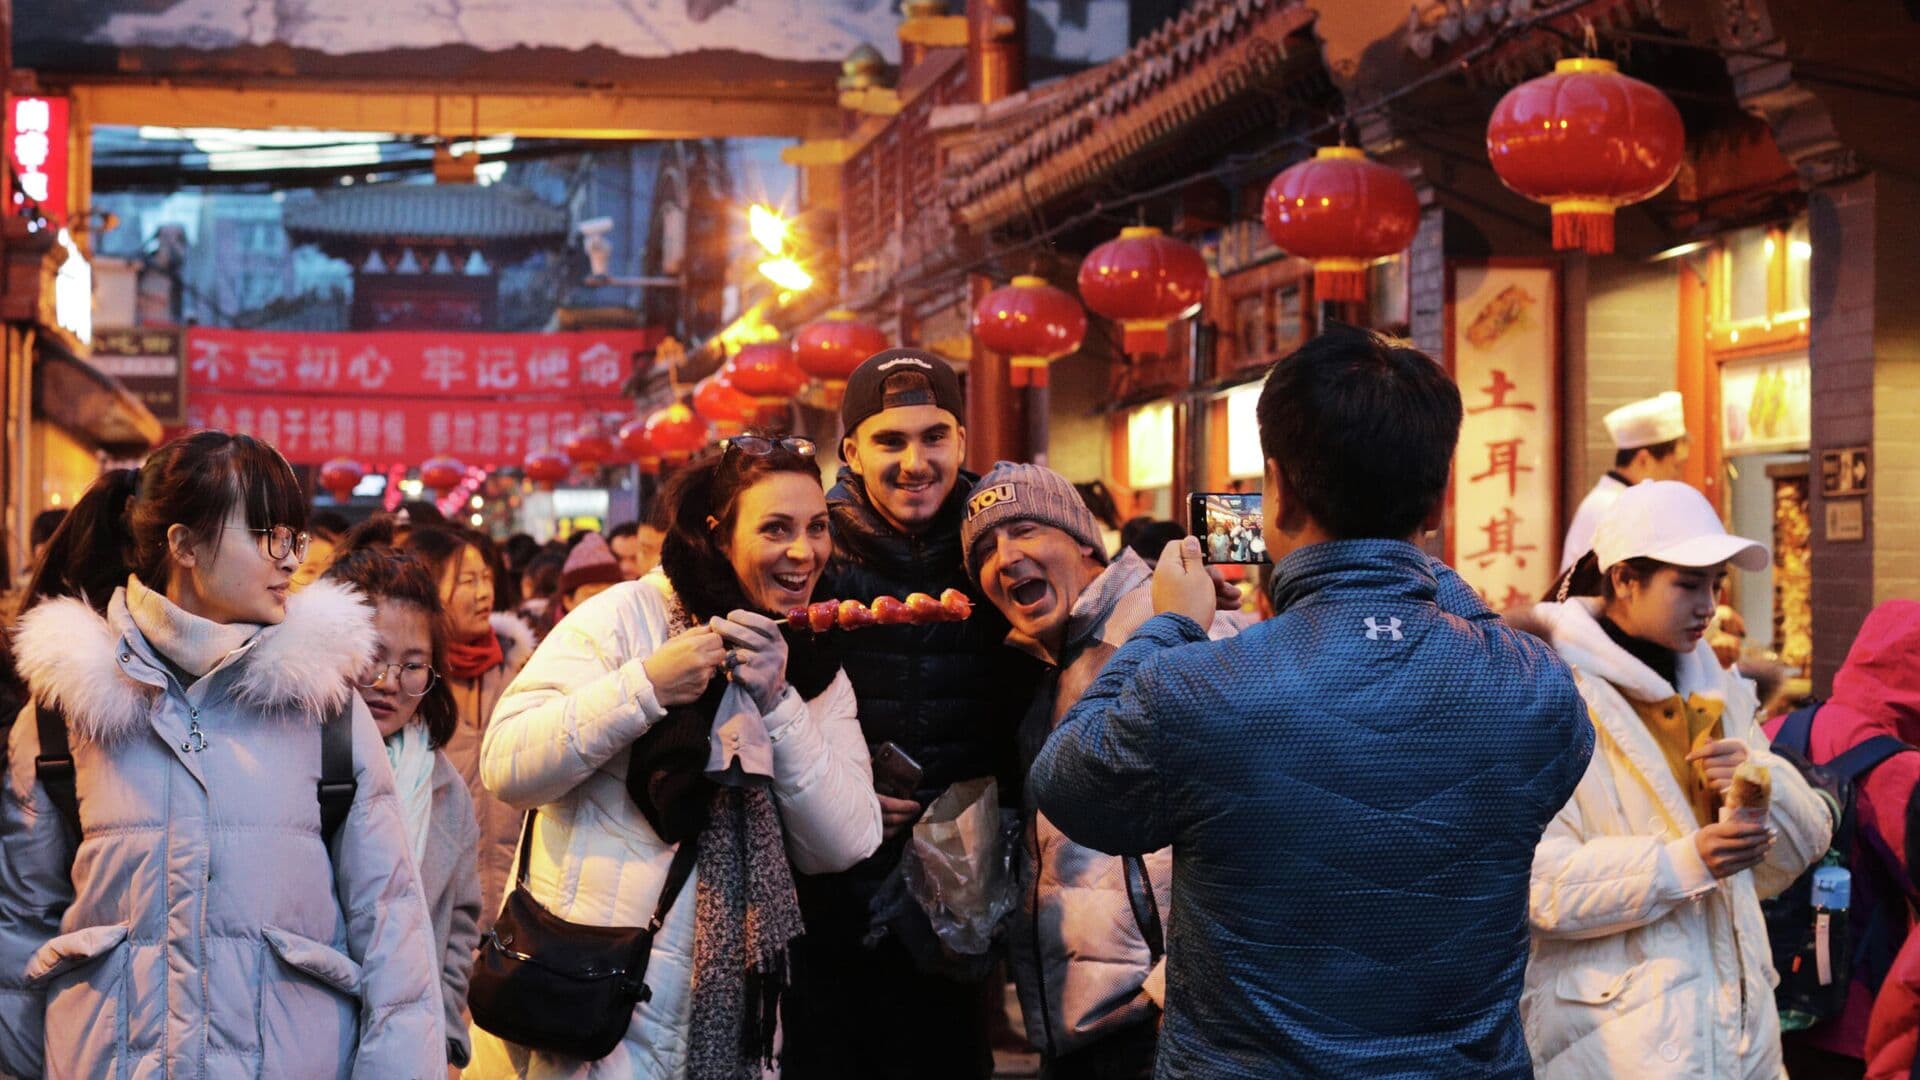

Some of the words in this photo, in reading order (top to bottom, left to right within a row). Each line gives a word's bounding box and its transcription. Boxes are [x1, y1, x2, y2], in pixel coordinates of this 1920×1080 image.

[191, 339, 392, 389] 不忘初心
[421, 342, 620, 390] 牢记使命
[969, 486, 1014, 513] YOU
